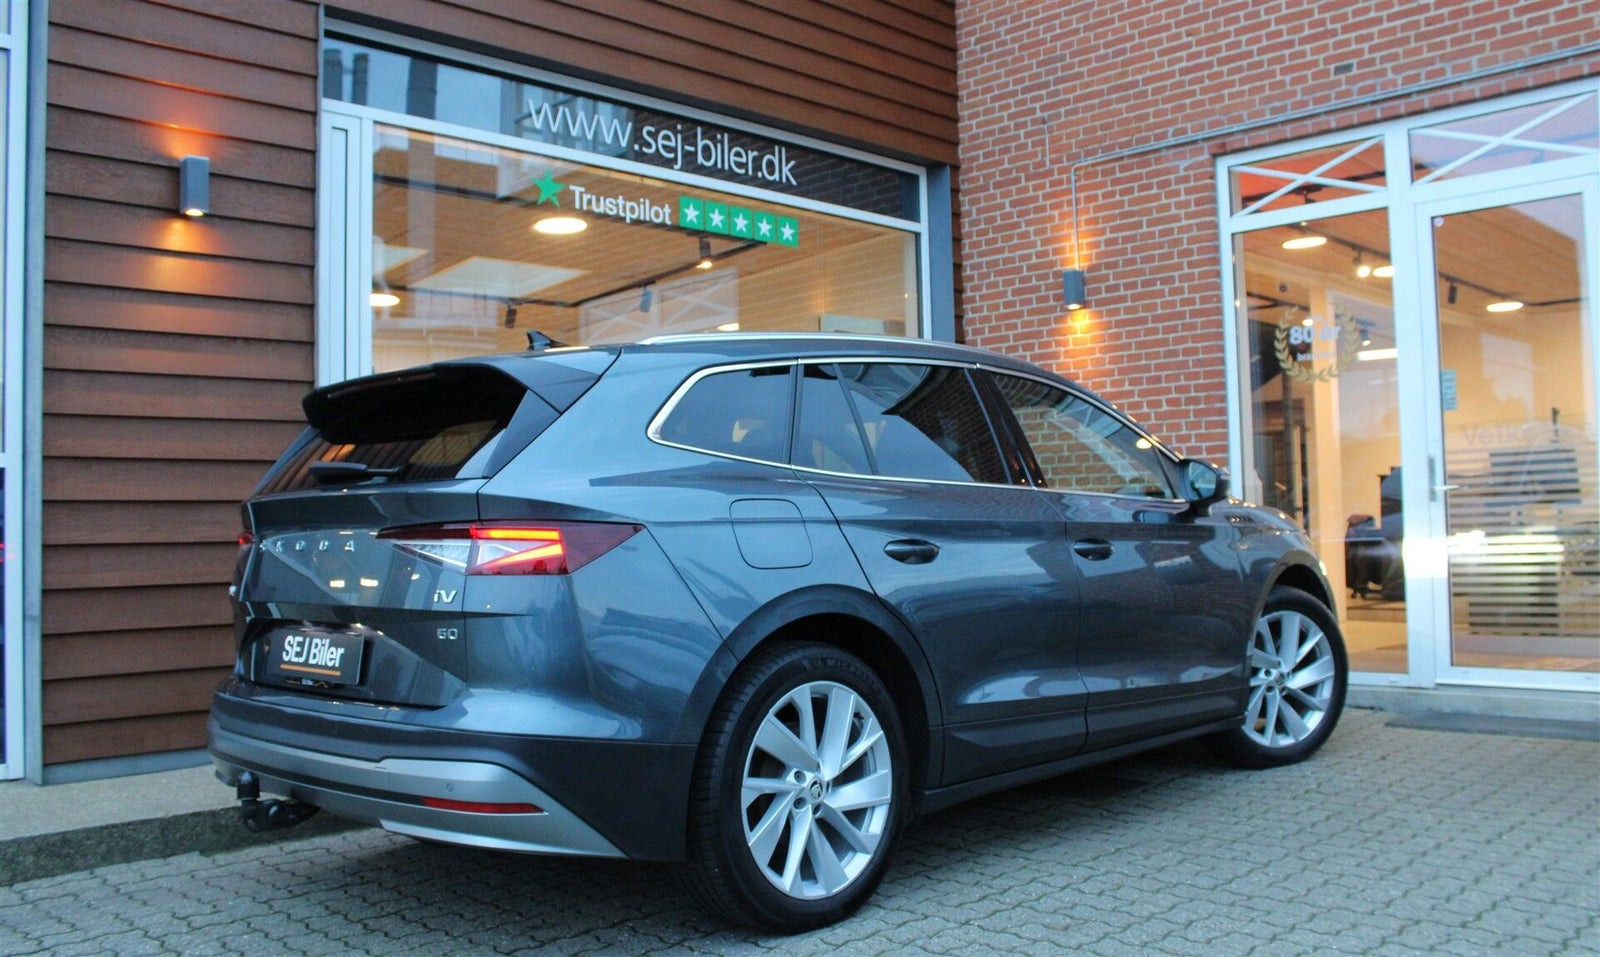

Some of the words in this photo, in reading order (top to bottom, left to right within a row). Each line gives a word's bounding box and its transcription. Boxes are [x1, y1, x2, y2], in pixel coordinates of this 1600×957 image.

[527, 99, 798, 187] www.sej-biler.dk
[569, 184, 672, 225] Trustpilot
[1289, 325, 1315, 345] 80
[433, 589, 458, 603] iV
[282, 635, 310, 663] SEJ
[309, 638, 345, 668] Biler
